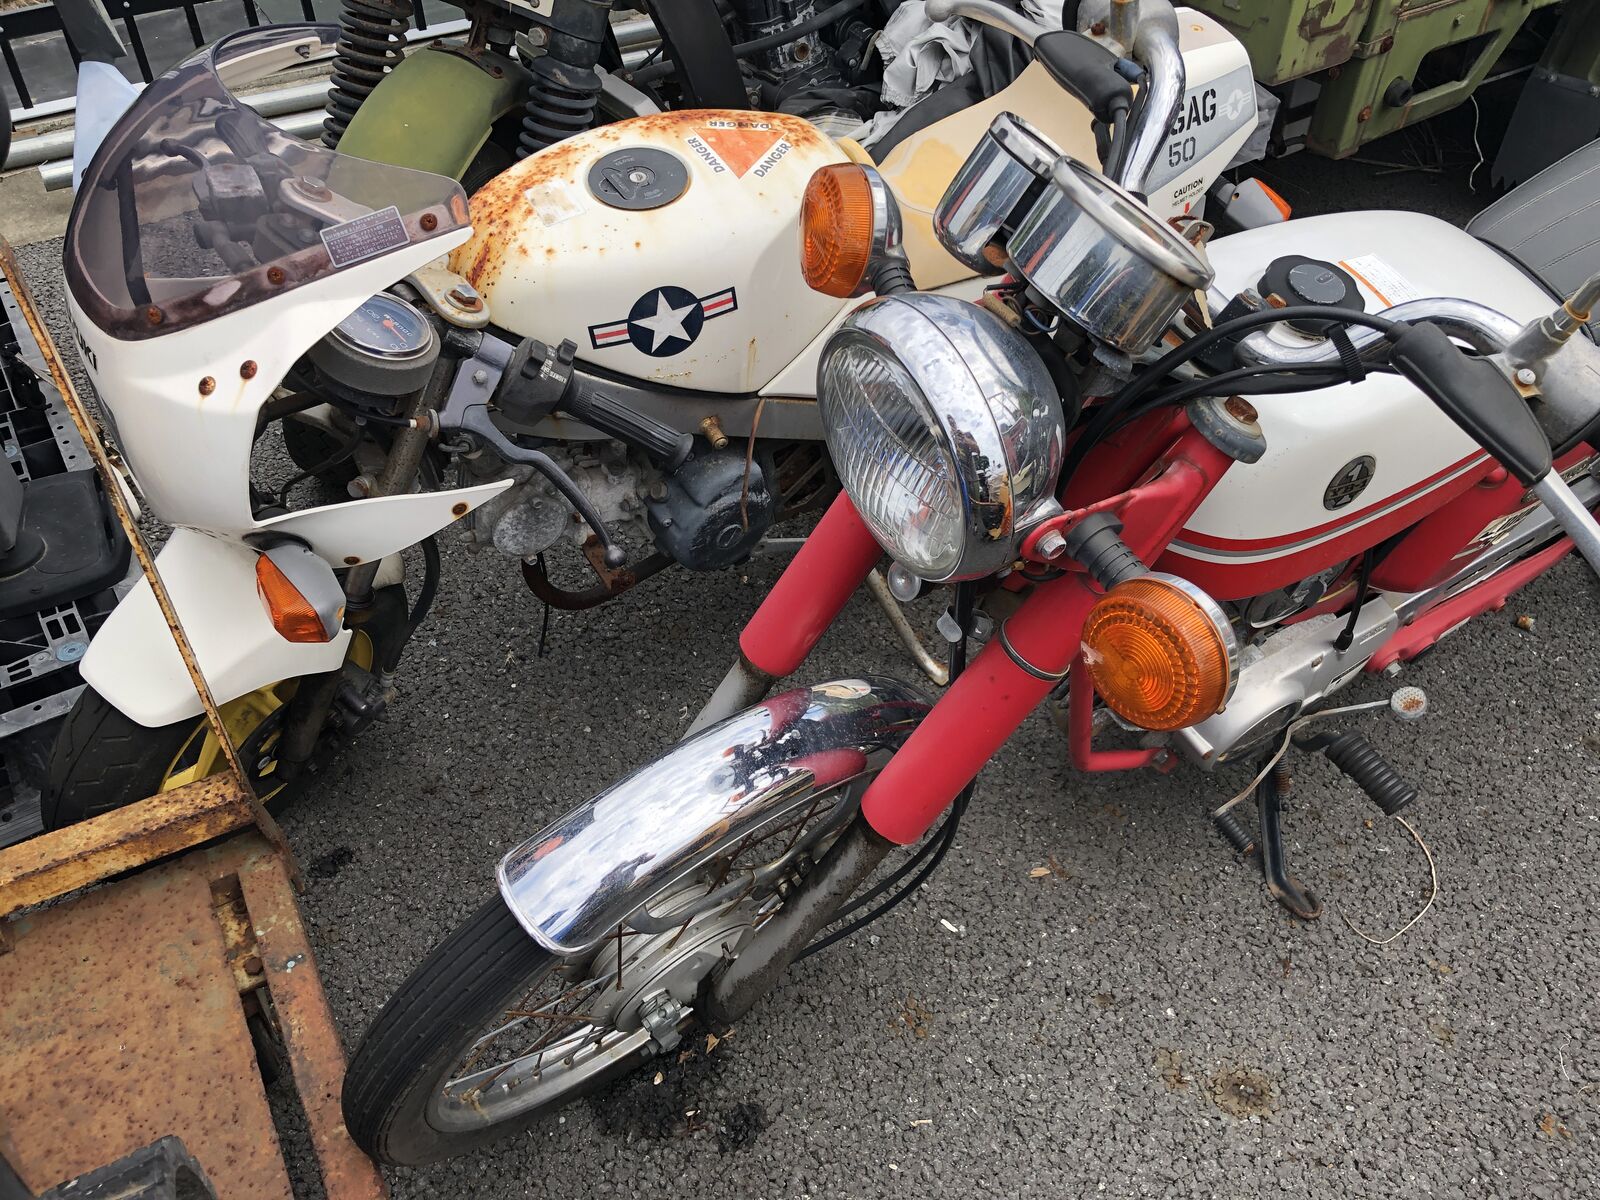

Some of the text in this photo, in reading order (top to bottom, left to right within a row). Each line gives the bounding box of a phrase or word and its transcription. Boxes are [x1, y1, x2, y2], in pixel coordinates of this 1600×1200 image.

[709, 121, 771, 129] DANGER
[687, 137, 726, 174] DANGER
[753, 141, 793, 178] DANGER
[1168, 136, 1196, 168] 50
[1173, 177, 1204, 198] CAUTION
